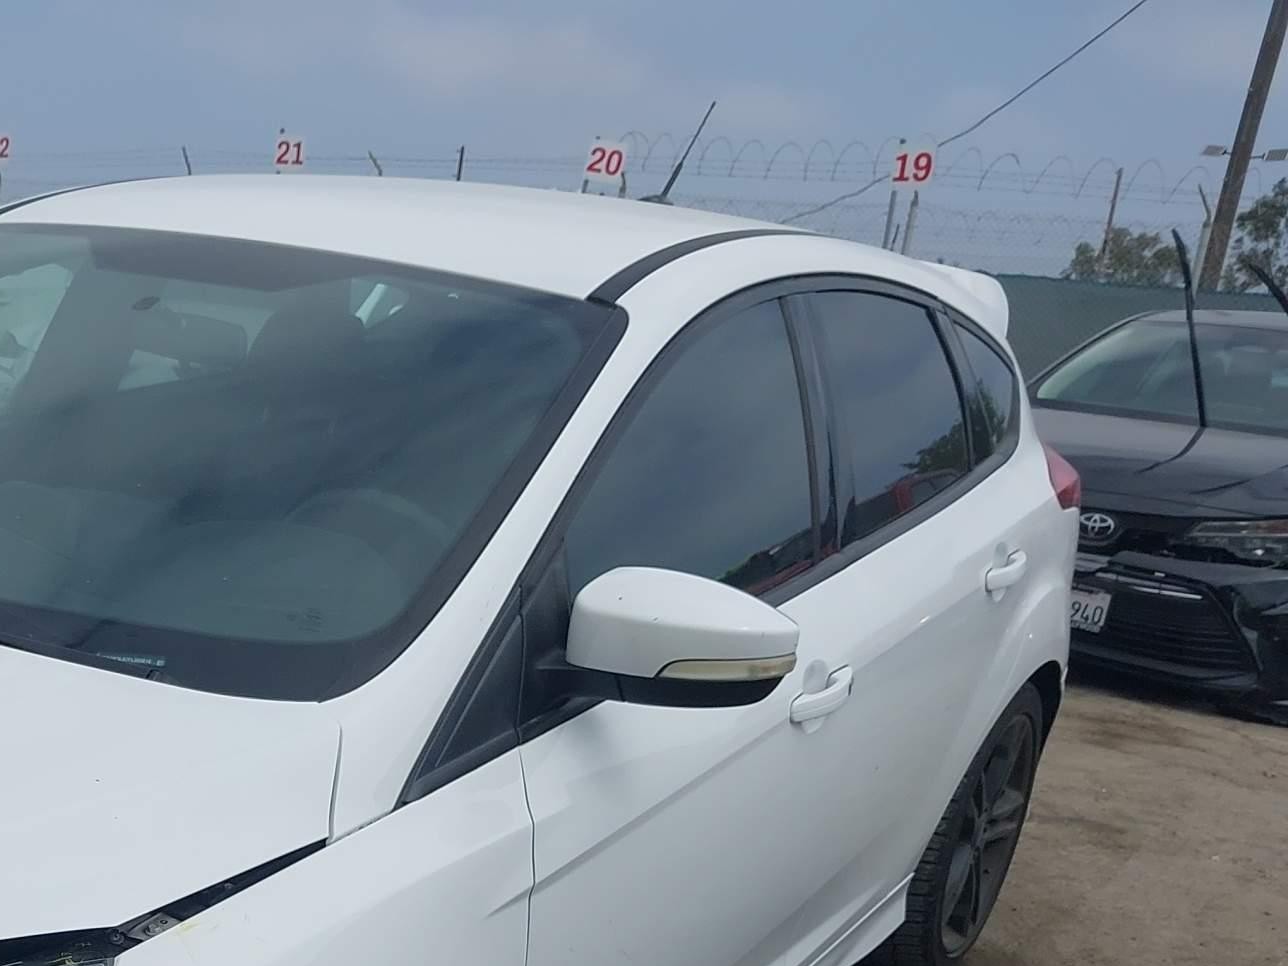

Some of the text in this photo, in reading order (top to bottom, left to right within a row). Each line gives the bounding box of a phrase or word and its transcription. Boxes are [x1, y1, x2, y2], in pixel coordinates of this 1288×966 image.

[276, 141, 303, 165] 21
[586, 147, 623, 176] 20
[892, 152, 932, 182] 19
